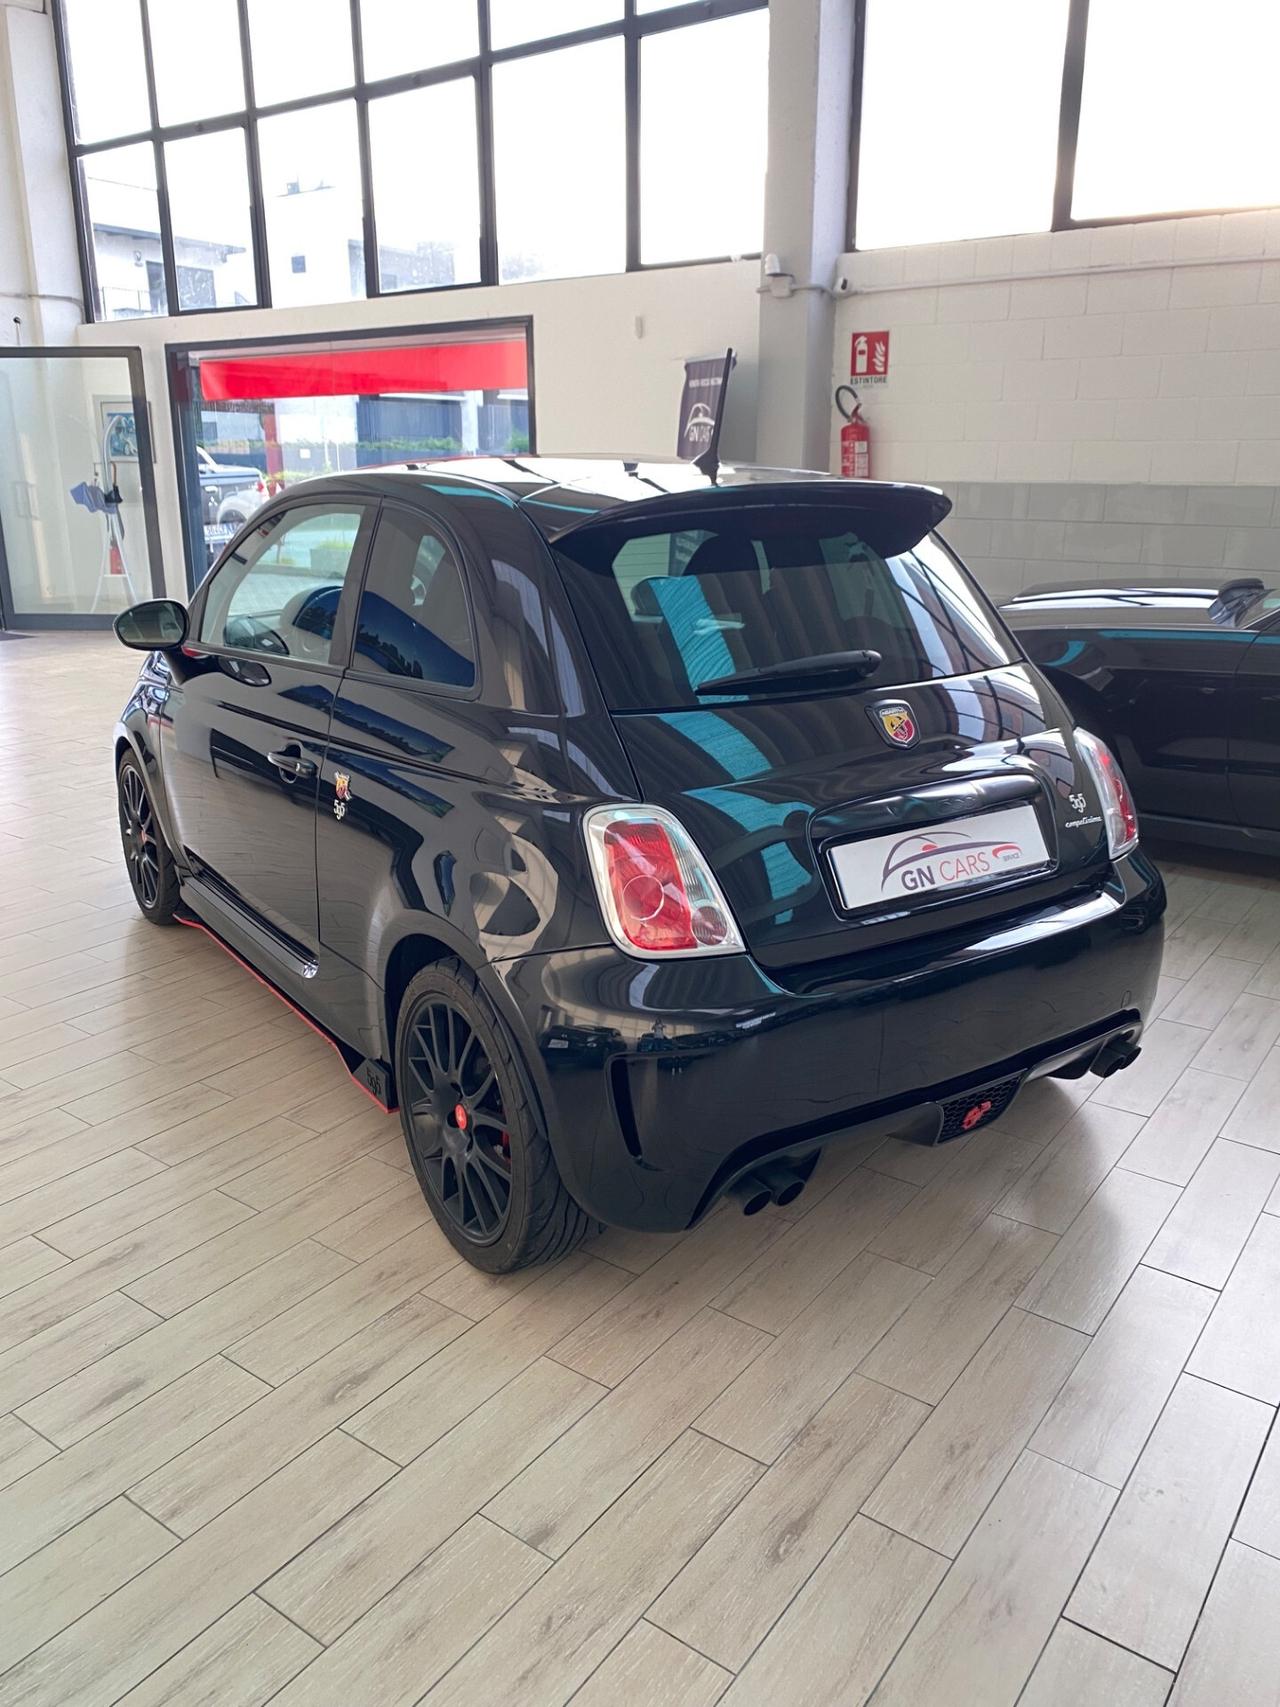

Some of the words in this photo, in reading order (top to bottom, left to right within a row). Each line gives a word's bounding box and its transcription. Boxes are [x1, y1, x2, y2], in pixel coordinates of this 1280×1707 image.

[850, 376, 887, 385] ESTINTORE
[901, 865, 936, 891] GN
[939, 852, 990, 881] CARS
